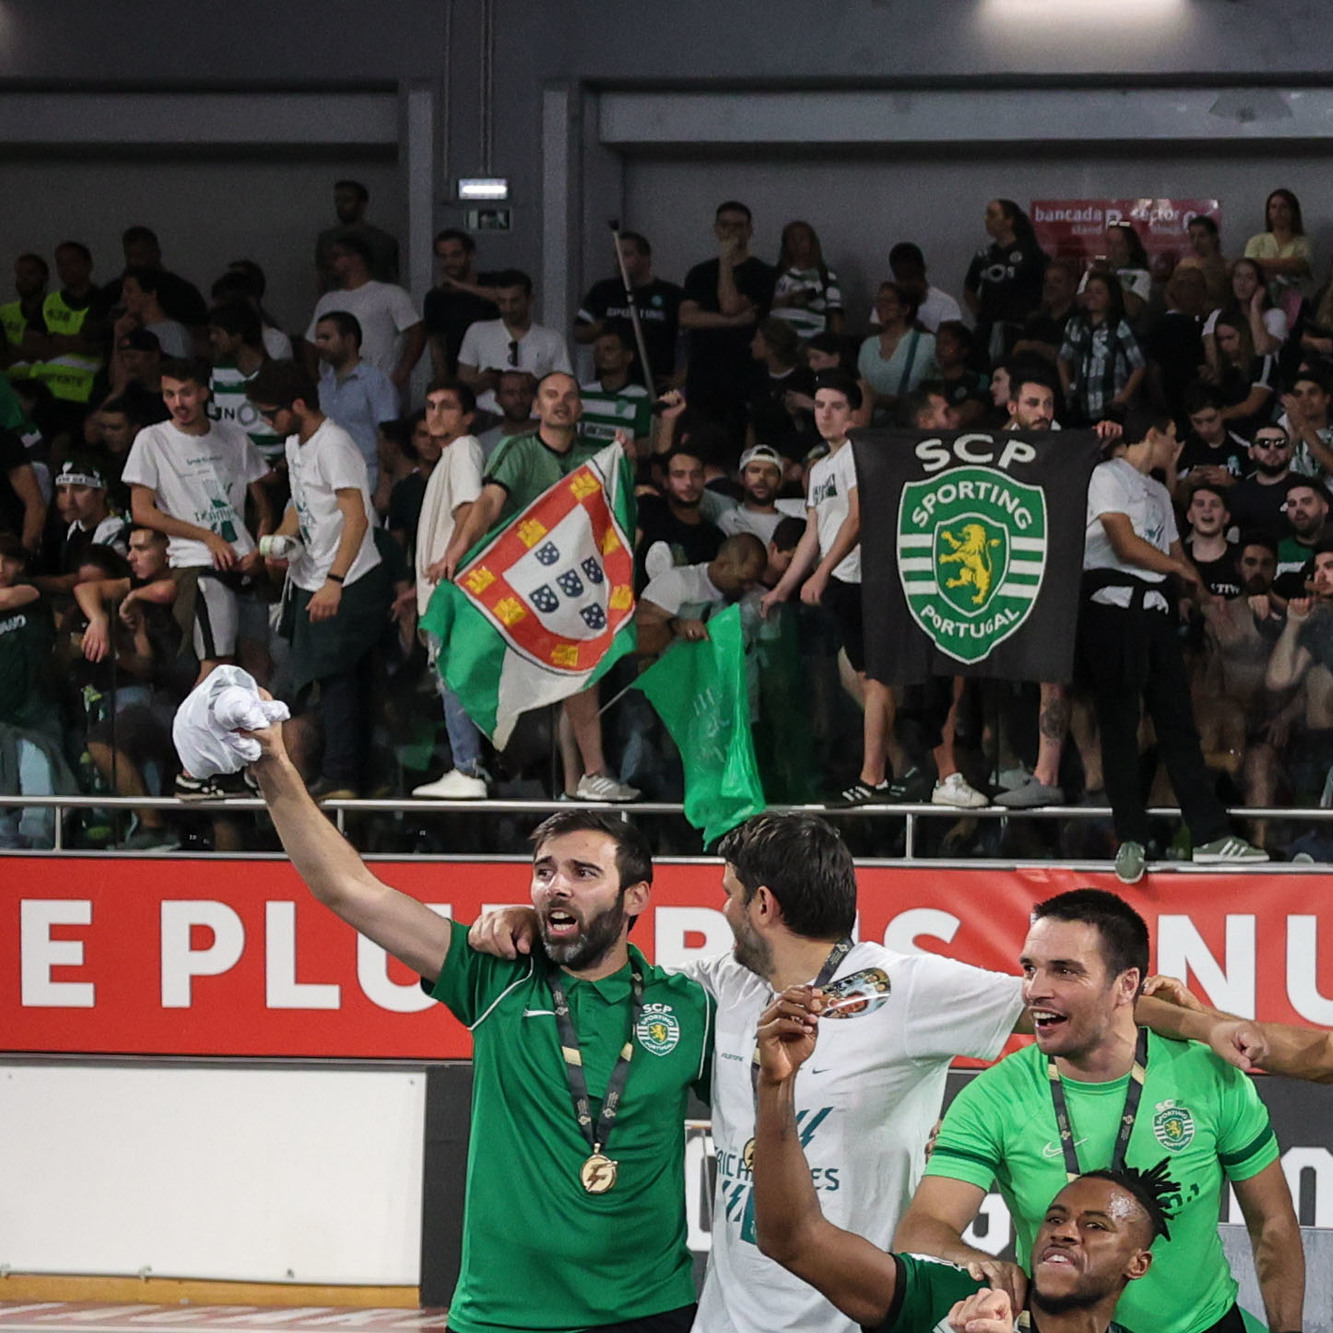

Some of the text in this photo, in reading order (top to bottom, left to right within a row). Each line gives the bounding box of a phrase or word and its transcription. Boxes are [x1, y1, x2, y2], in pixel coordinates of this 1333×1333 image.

[1034, 206, 1101, 224] bancada
[915, 433, 1036, 472] SCP
[912, 481, 1032, 530] SPORTING
[920, 604, 1020, 638] PORTUGAL
[21, 900, 95, 1008] E
[641, 1013, 676, 1028] SPORTING
[642, 1003, 673, 1014] SCP
